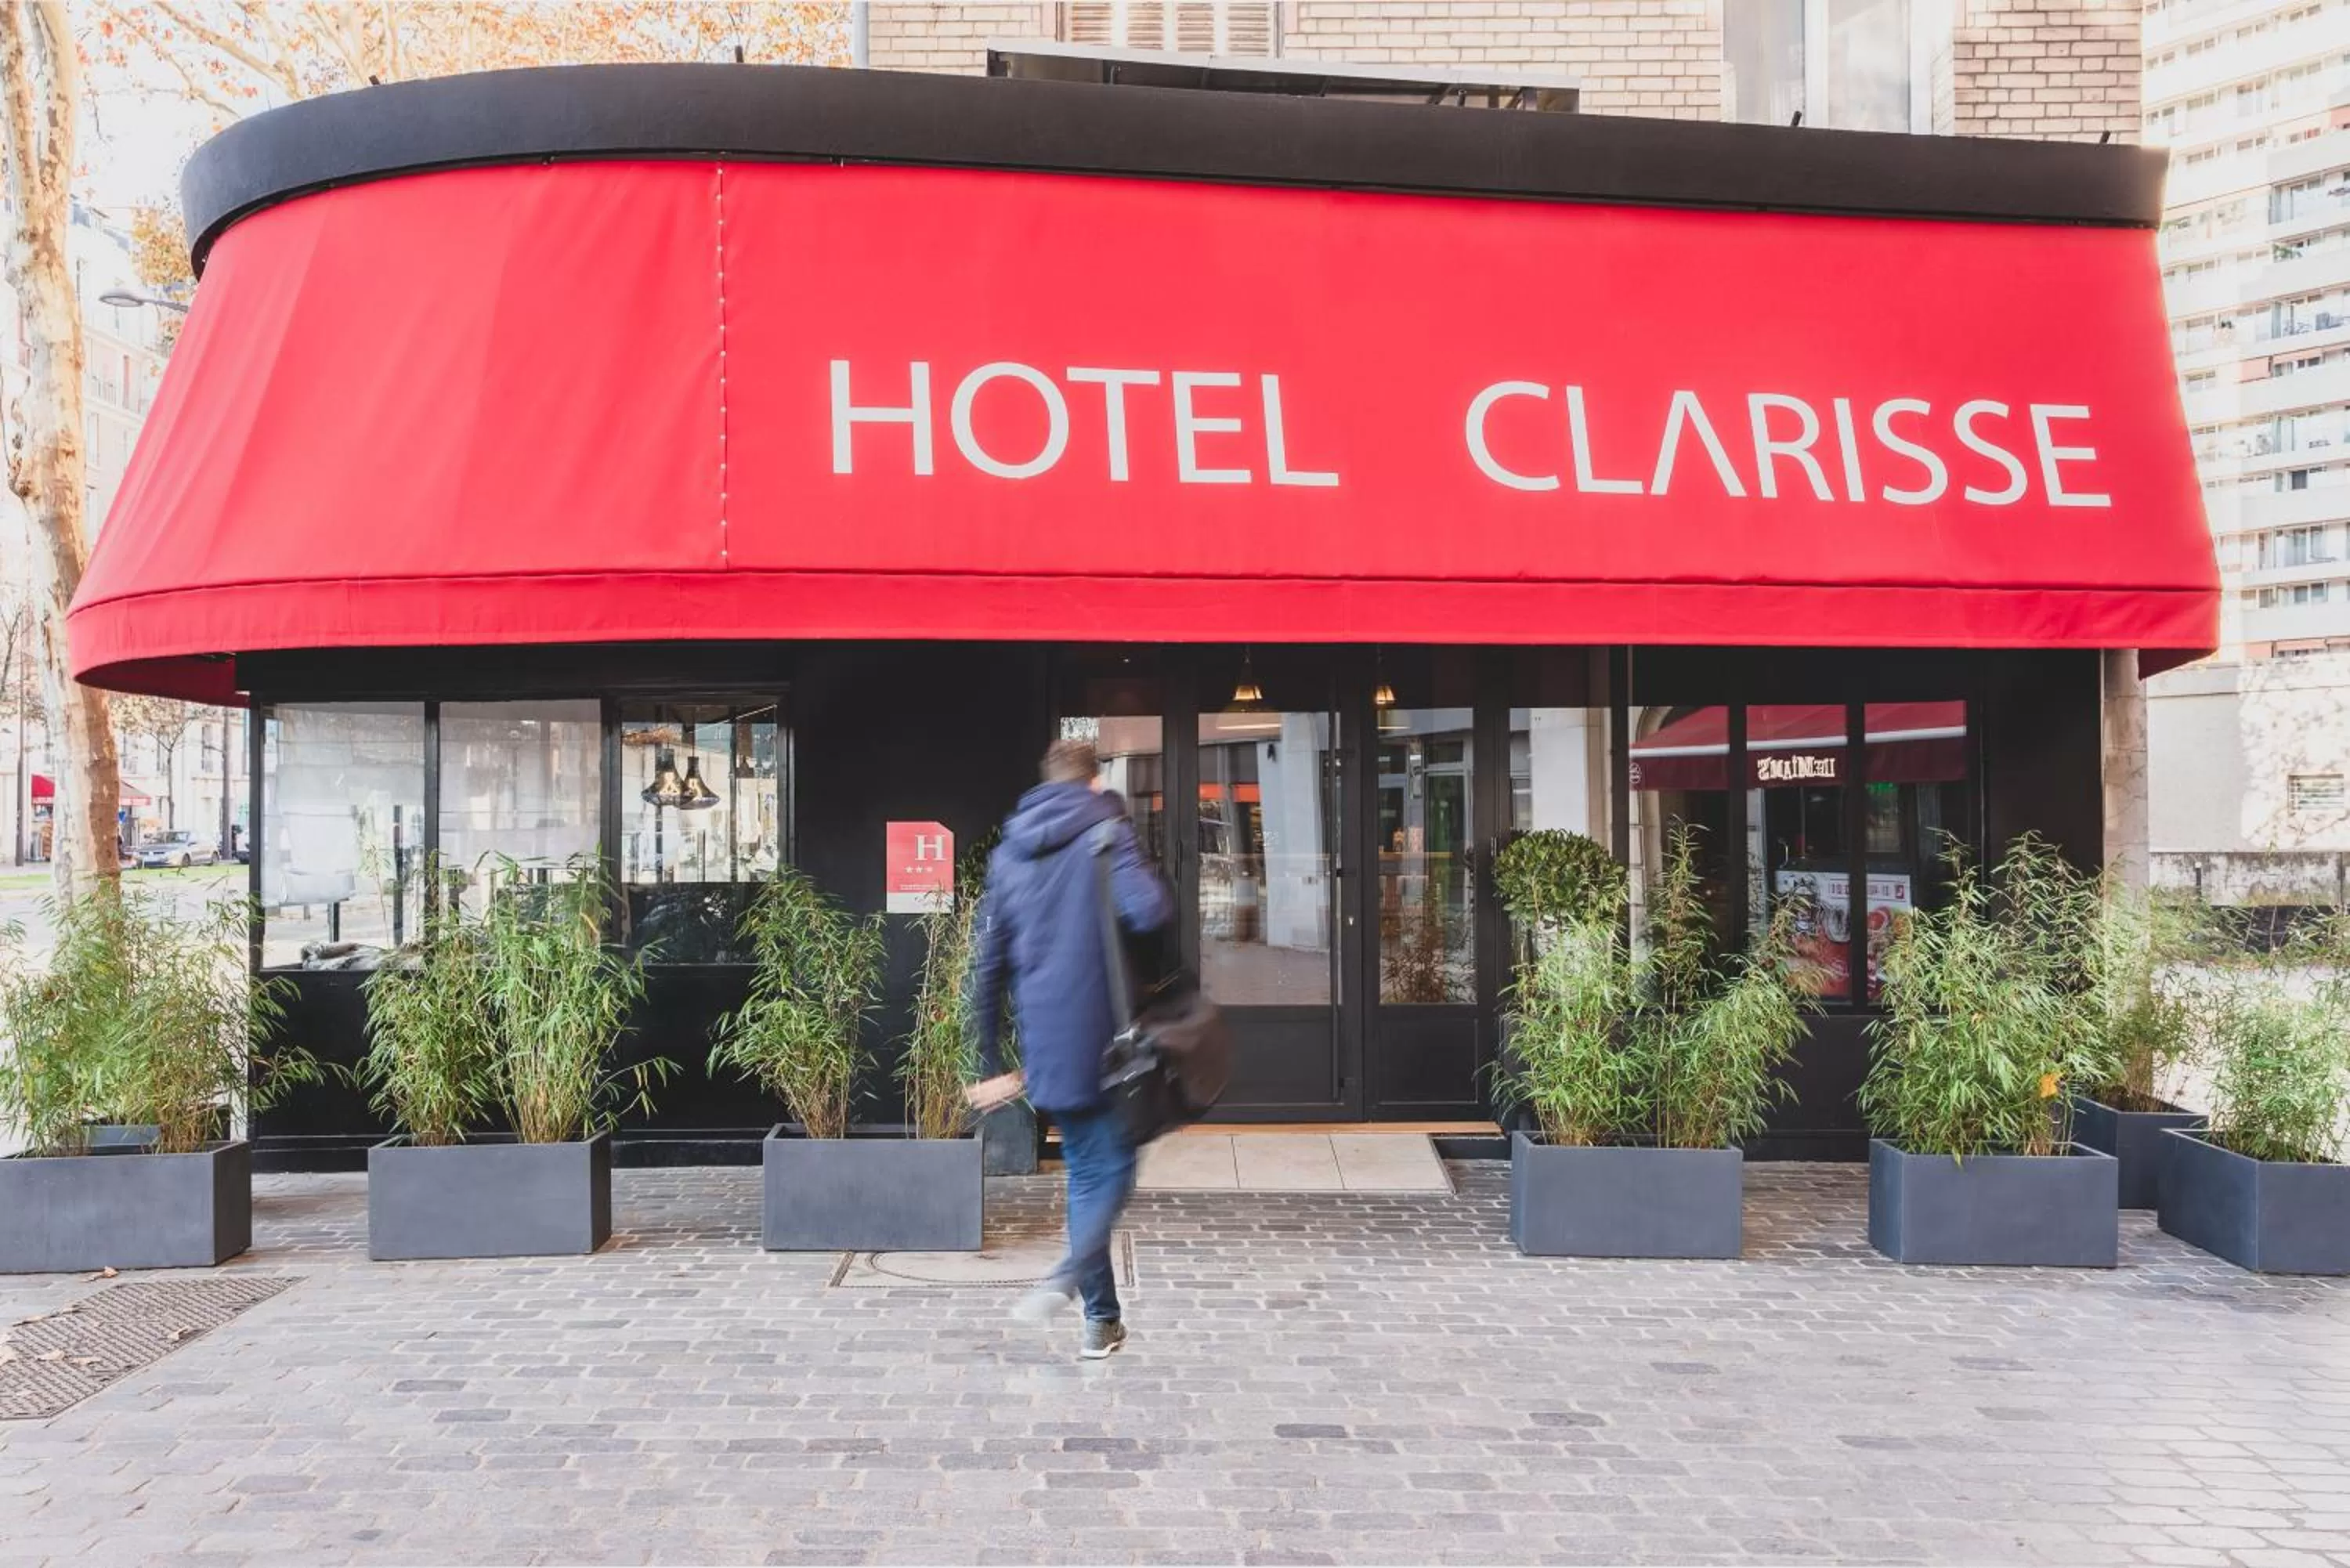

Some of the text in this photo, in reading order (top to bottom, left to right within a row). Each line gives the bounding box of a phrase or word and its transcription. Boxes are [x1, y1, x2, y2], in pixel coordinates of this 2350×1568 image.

[830, 359, 2111, 507] HOTEL CLARISSE
[915, 834, 946, 861] H
